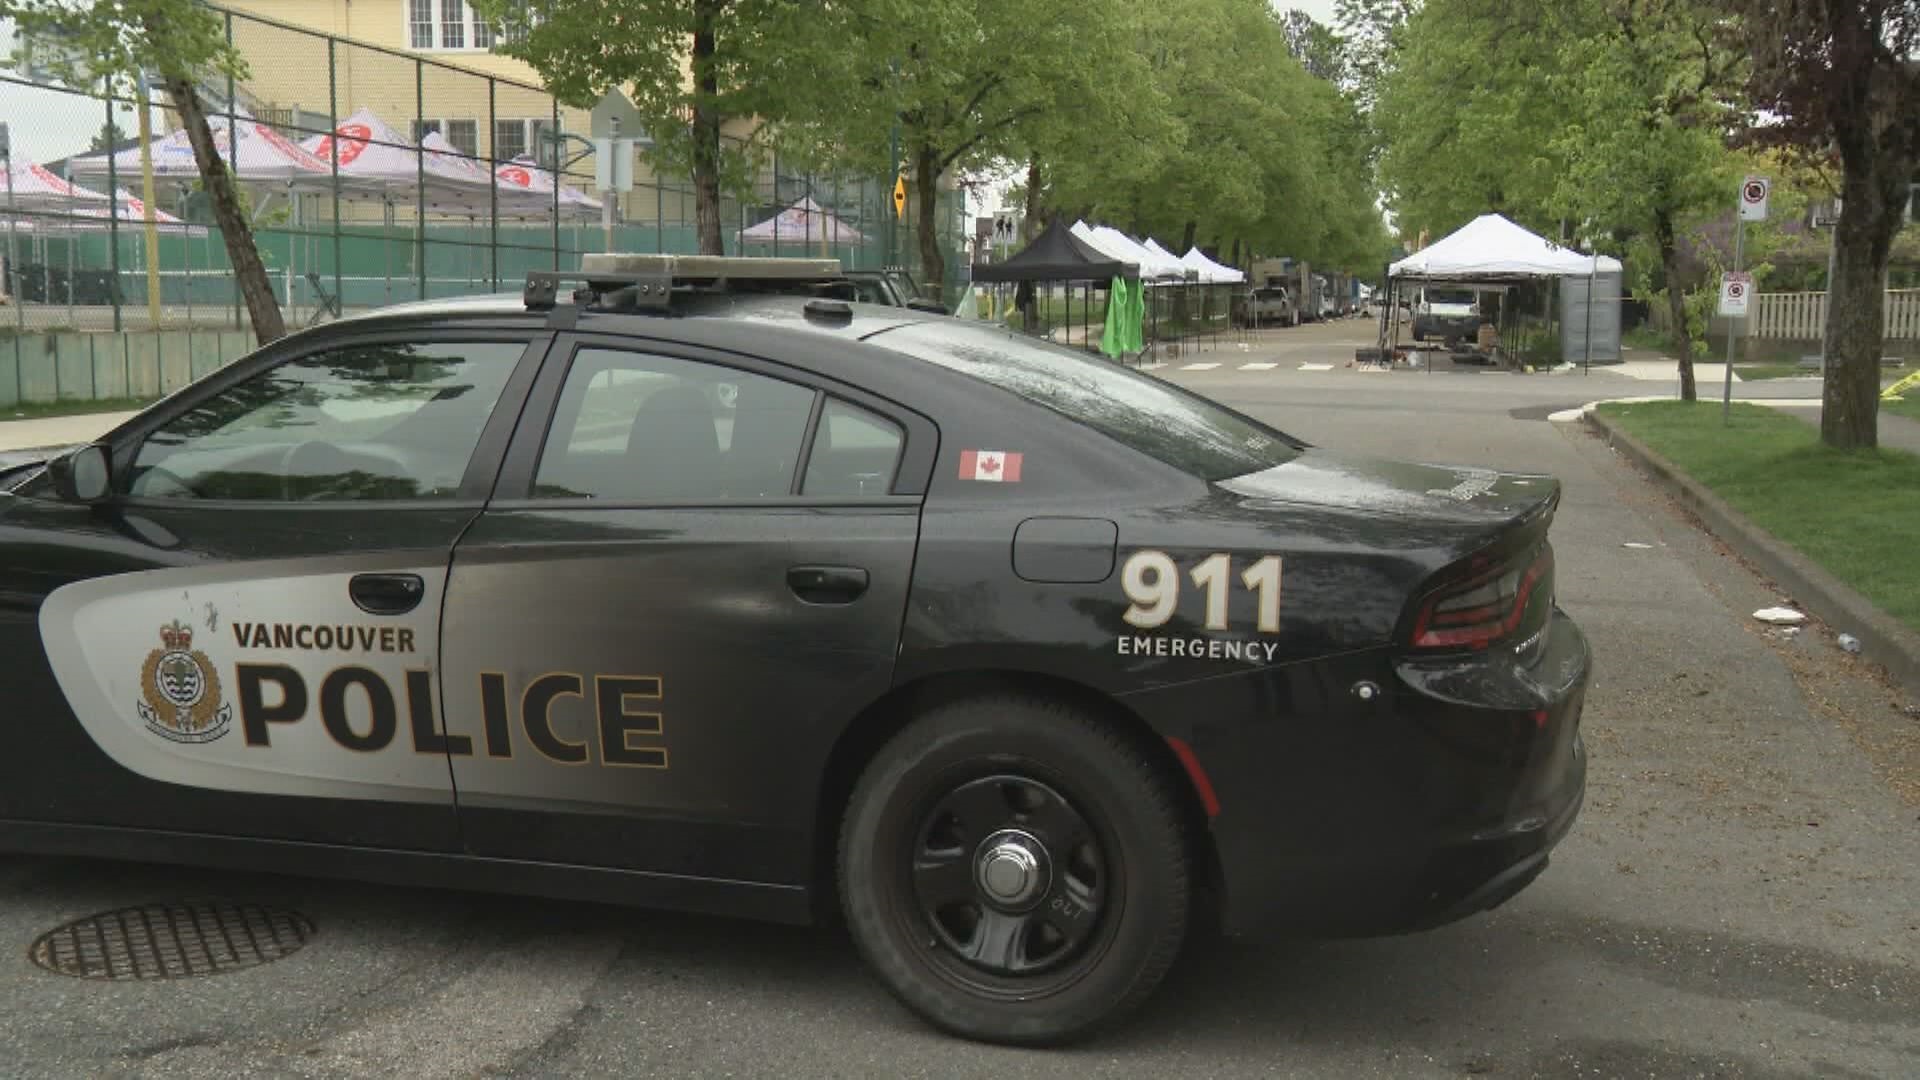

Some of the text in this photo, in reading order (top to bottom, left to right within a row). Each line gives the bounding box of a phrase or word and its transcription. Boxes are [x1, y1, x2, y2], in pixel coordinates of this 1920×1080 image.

[1121, 550, 1282, 632] 911
[232, 622, 416, 652] VANCOUVER
[1117, 637, 1278, 661] EMERGENCY
[235, 662, 669, 769] POLICE
